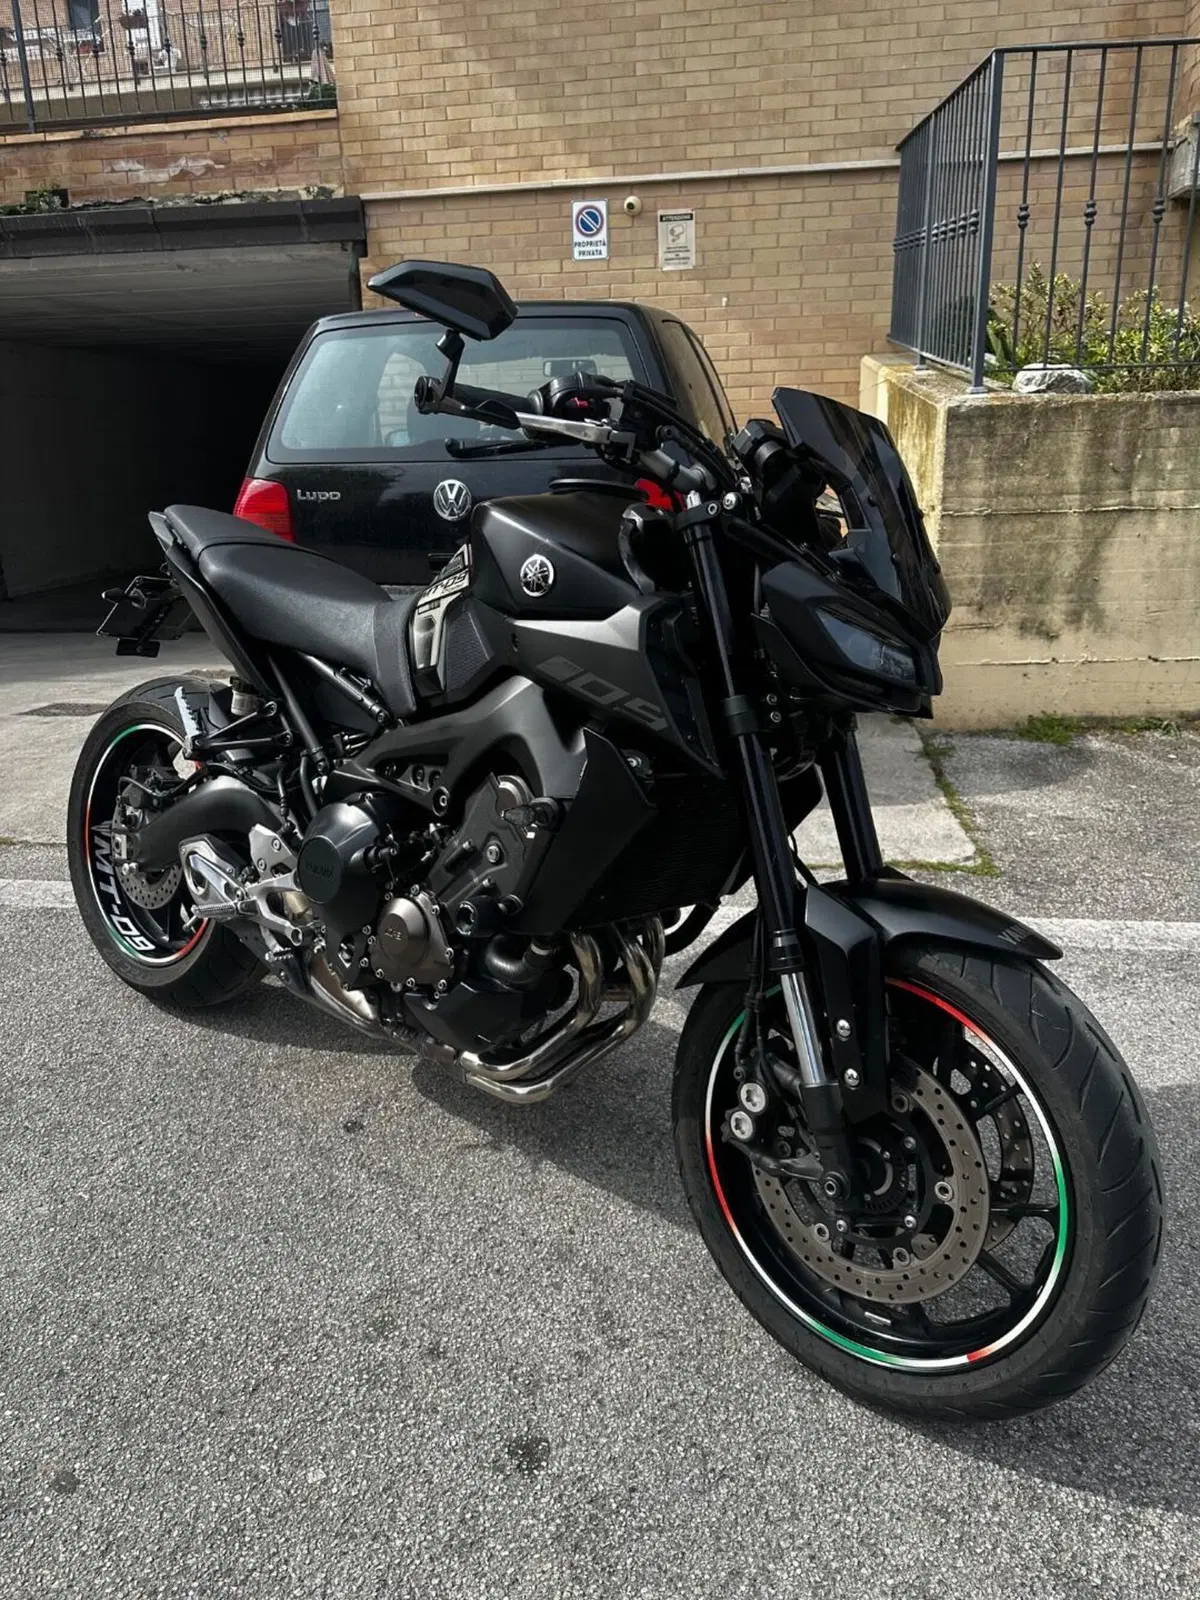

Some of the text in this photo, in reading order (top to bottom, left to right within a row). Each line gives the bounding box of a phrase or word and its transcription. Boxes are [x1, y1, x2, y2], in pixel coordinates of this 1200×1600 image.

[574, 239, 607, 248] PROPRIETÀ
[578, 249, 603, 257] PRIVATA
[297, 489, 341, 503] Lupo
[94, 833, 156, 951] MT-09
